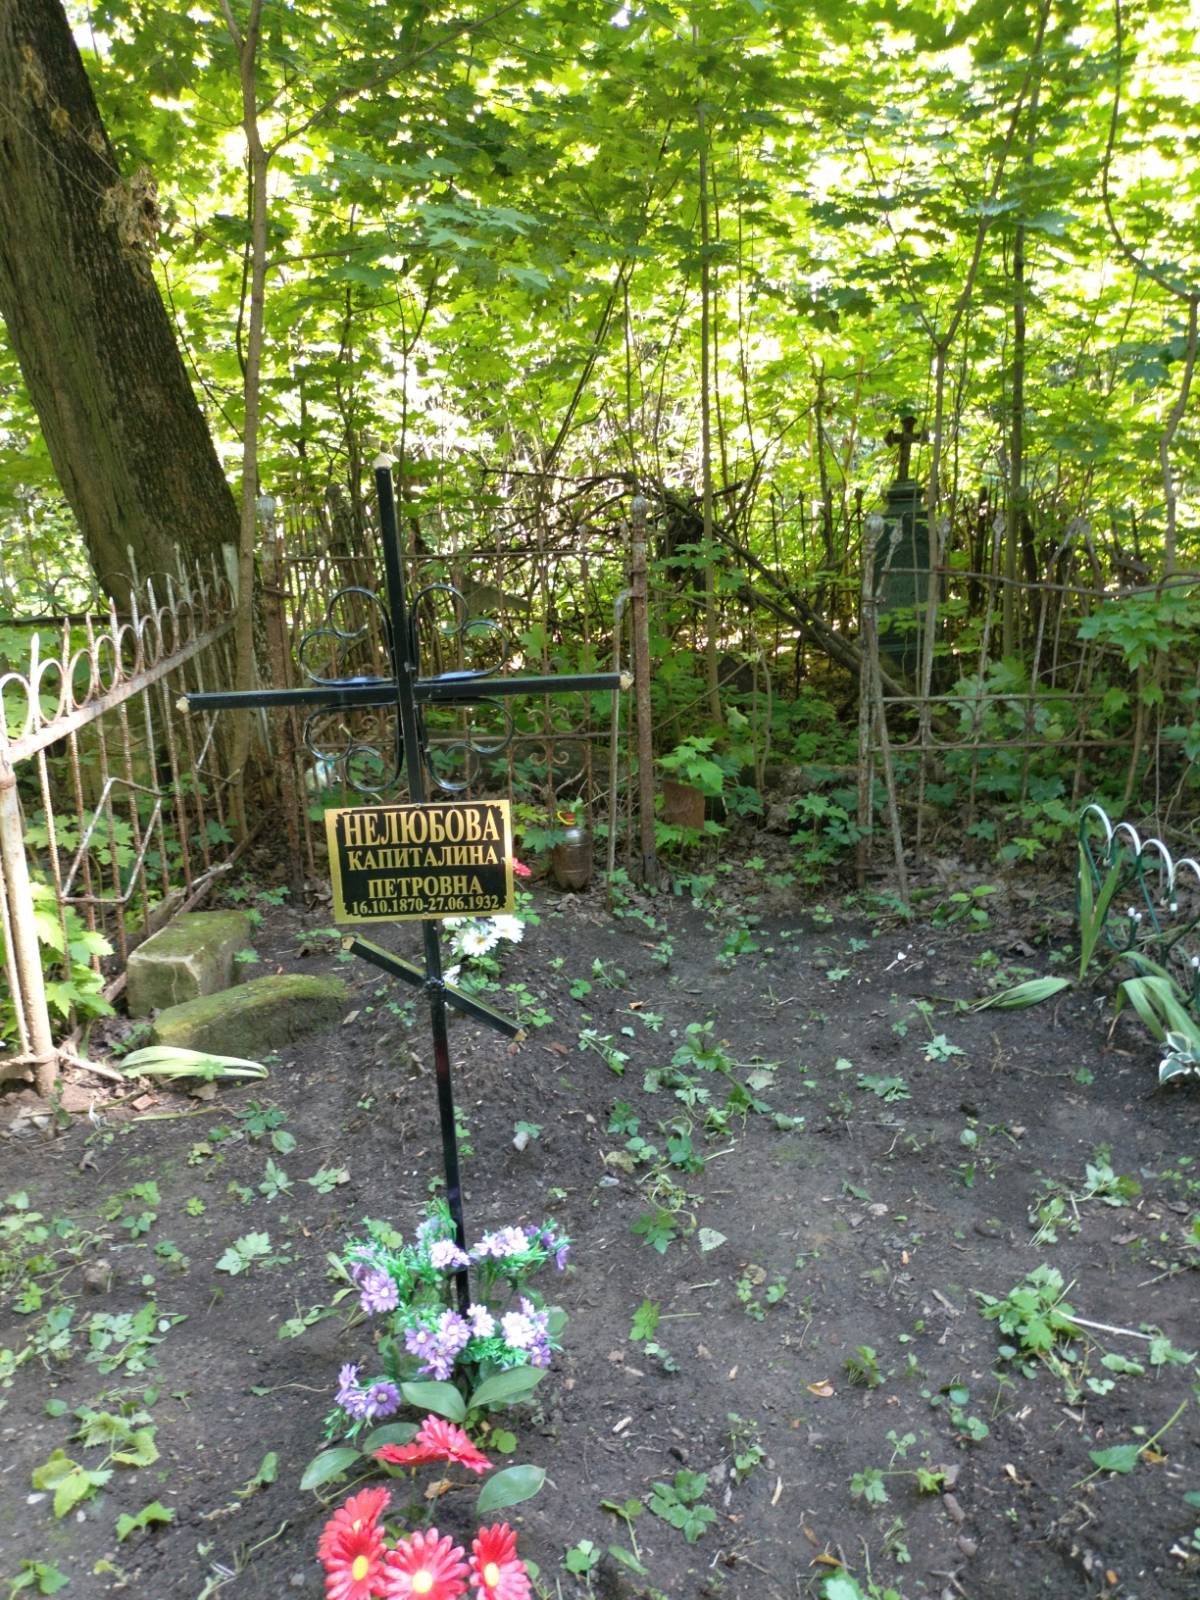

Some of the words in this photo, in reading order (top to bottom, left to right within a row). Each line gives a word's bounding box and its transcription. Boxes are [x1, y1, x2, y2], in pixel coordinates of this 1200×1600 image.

[343, 808, 500, 847] НЕЛЮБОВА
[347, 845, 498, 871] КАПИТАЛИНА
[367, 875, 483, 899] ПЕТРОВНА
[352, 895, 499, 915] 16.10.1870-27.06.1932
